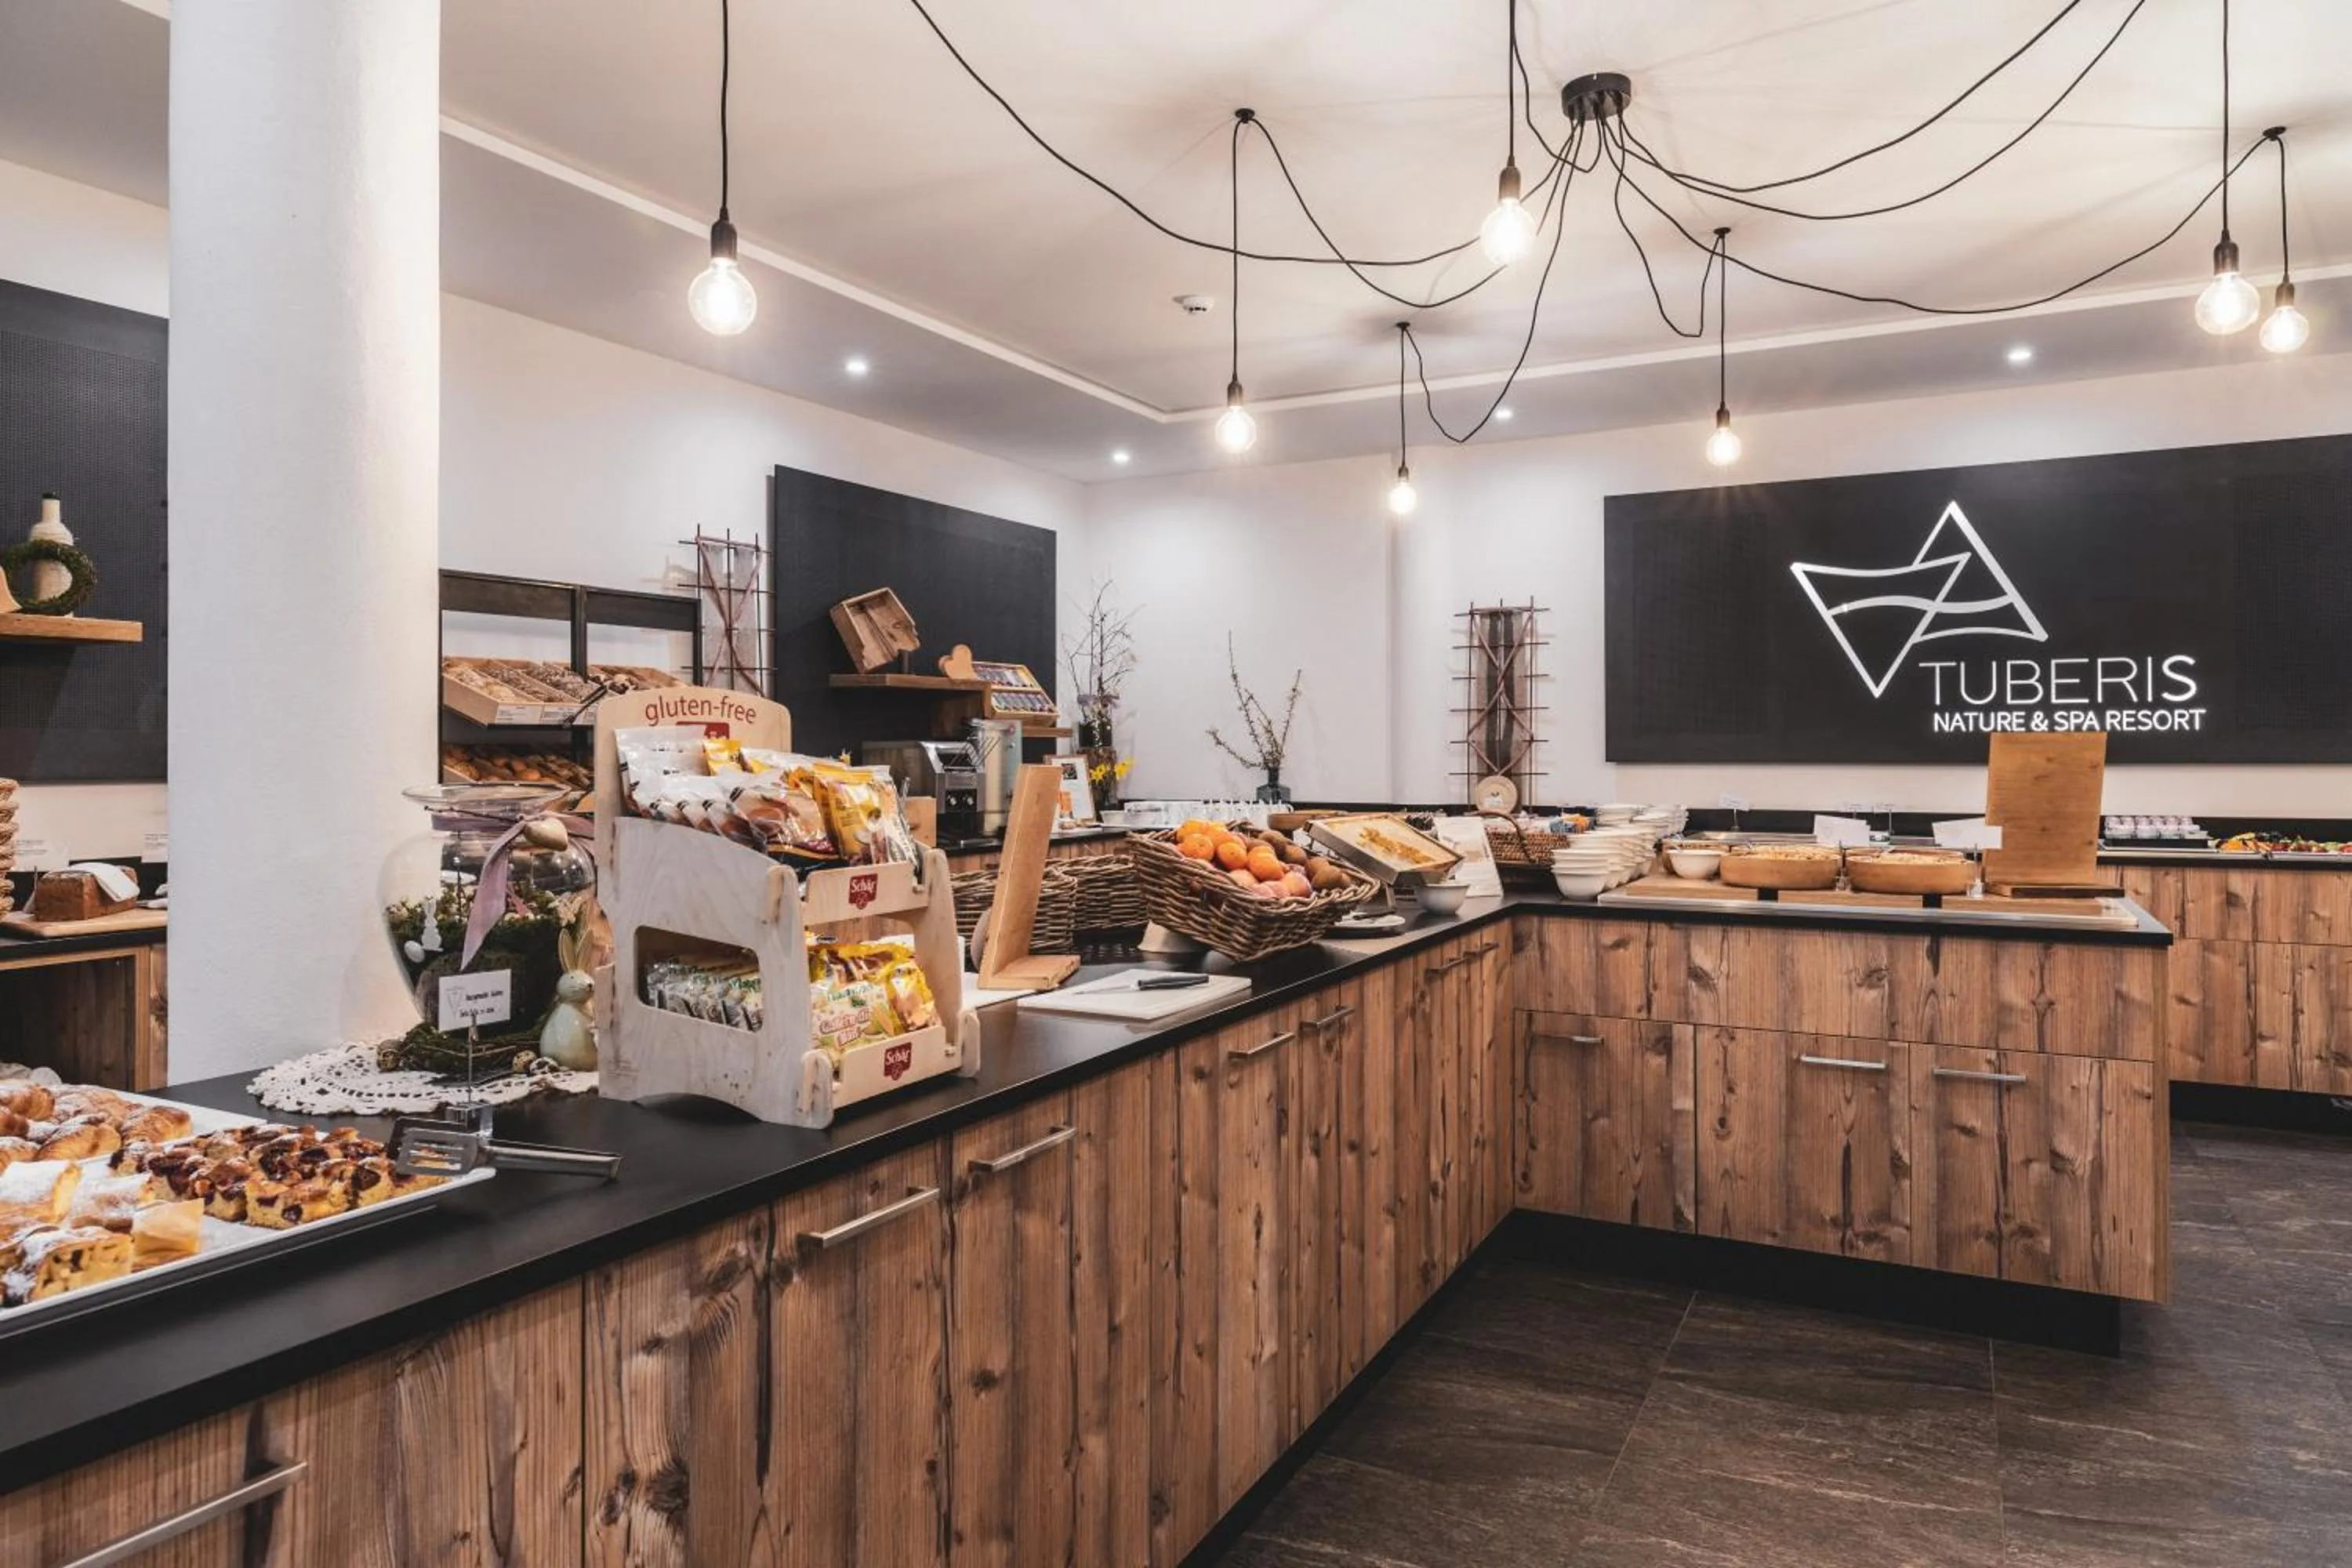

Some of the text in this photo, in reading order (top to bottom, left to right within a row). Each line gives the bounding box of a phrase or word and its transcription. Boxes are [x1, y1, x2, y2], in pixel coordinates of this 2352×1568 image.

[1918, 655, 2197, 705] TUBERIS
[645, 695, 757, 727] gluten-free
[1933, 709, 2206, 732] NATURE & SPA RESORT
